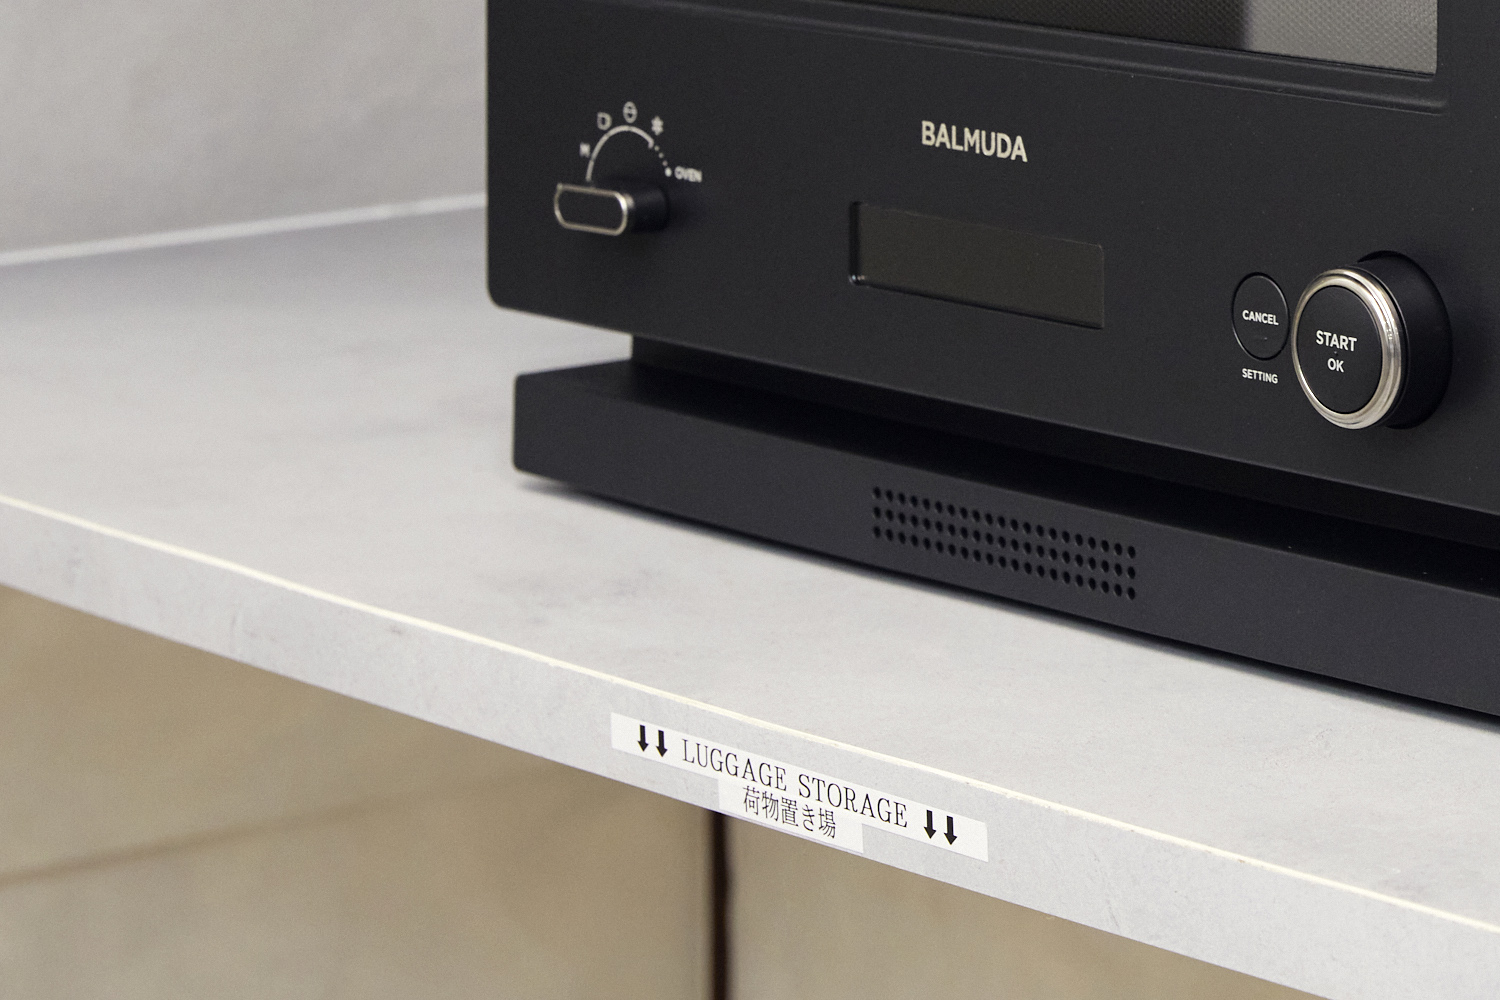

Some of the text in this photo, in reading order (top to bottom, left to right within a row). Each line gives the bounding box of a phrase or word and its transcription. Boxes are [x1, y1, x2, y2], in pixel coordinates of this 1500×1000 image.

[921, 120, 1029, 163] BALMUDA
[674, 165, 702, 183] OVEN
[1242, 309, 1279, 326] CANCEL
[1316, 330, 1358, 352] START
[1327, 357, 1345, 373] OK
[1241, 367, 1279, 384] SETTING
[682, 738, 908, 829] LUGGAGE STORAGE
[742, 785, 837, 839] 荷物置き場
